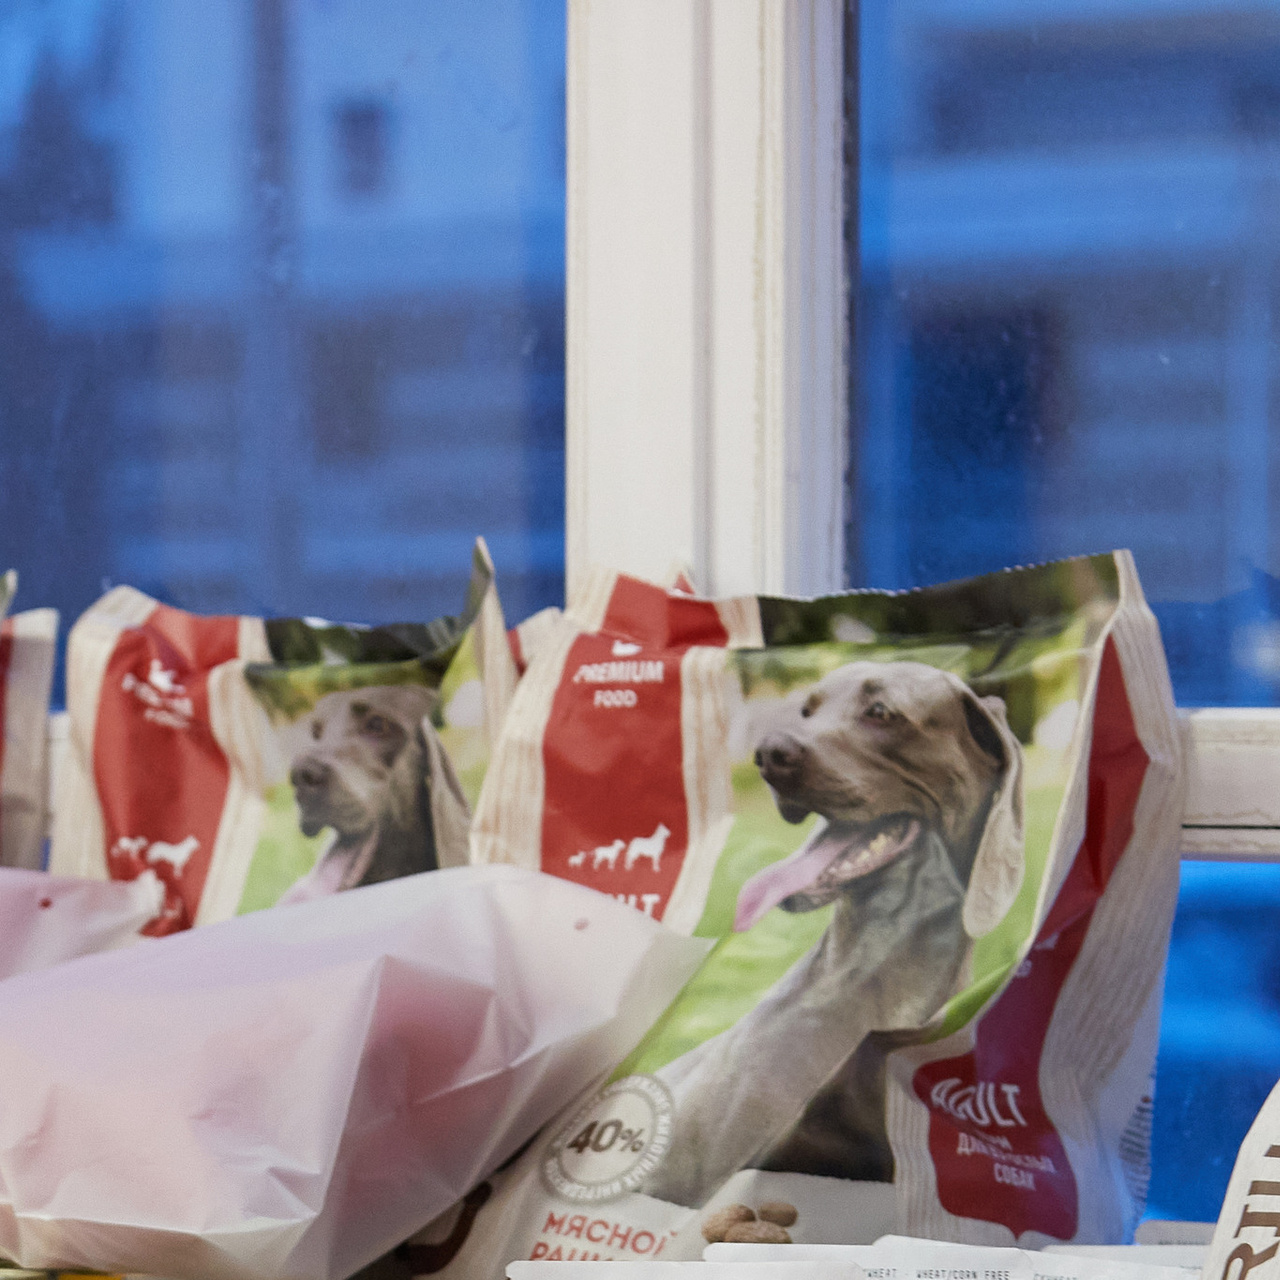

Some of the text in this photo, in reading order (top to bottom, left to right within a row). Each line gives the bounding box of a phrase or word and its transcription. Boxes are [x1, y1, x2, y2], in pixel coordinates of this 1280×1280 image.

[573, 661, 664, 684] PREMIUM
[594, 689, 638, 708] FOOD
[567, 1119, 645, 1154] 40%
[863, 1268, 1011, 1280] WHEAT WHEAT/CORN FREE
